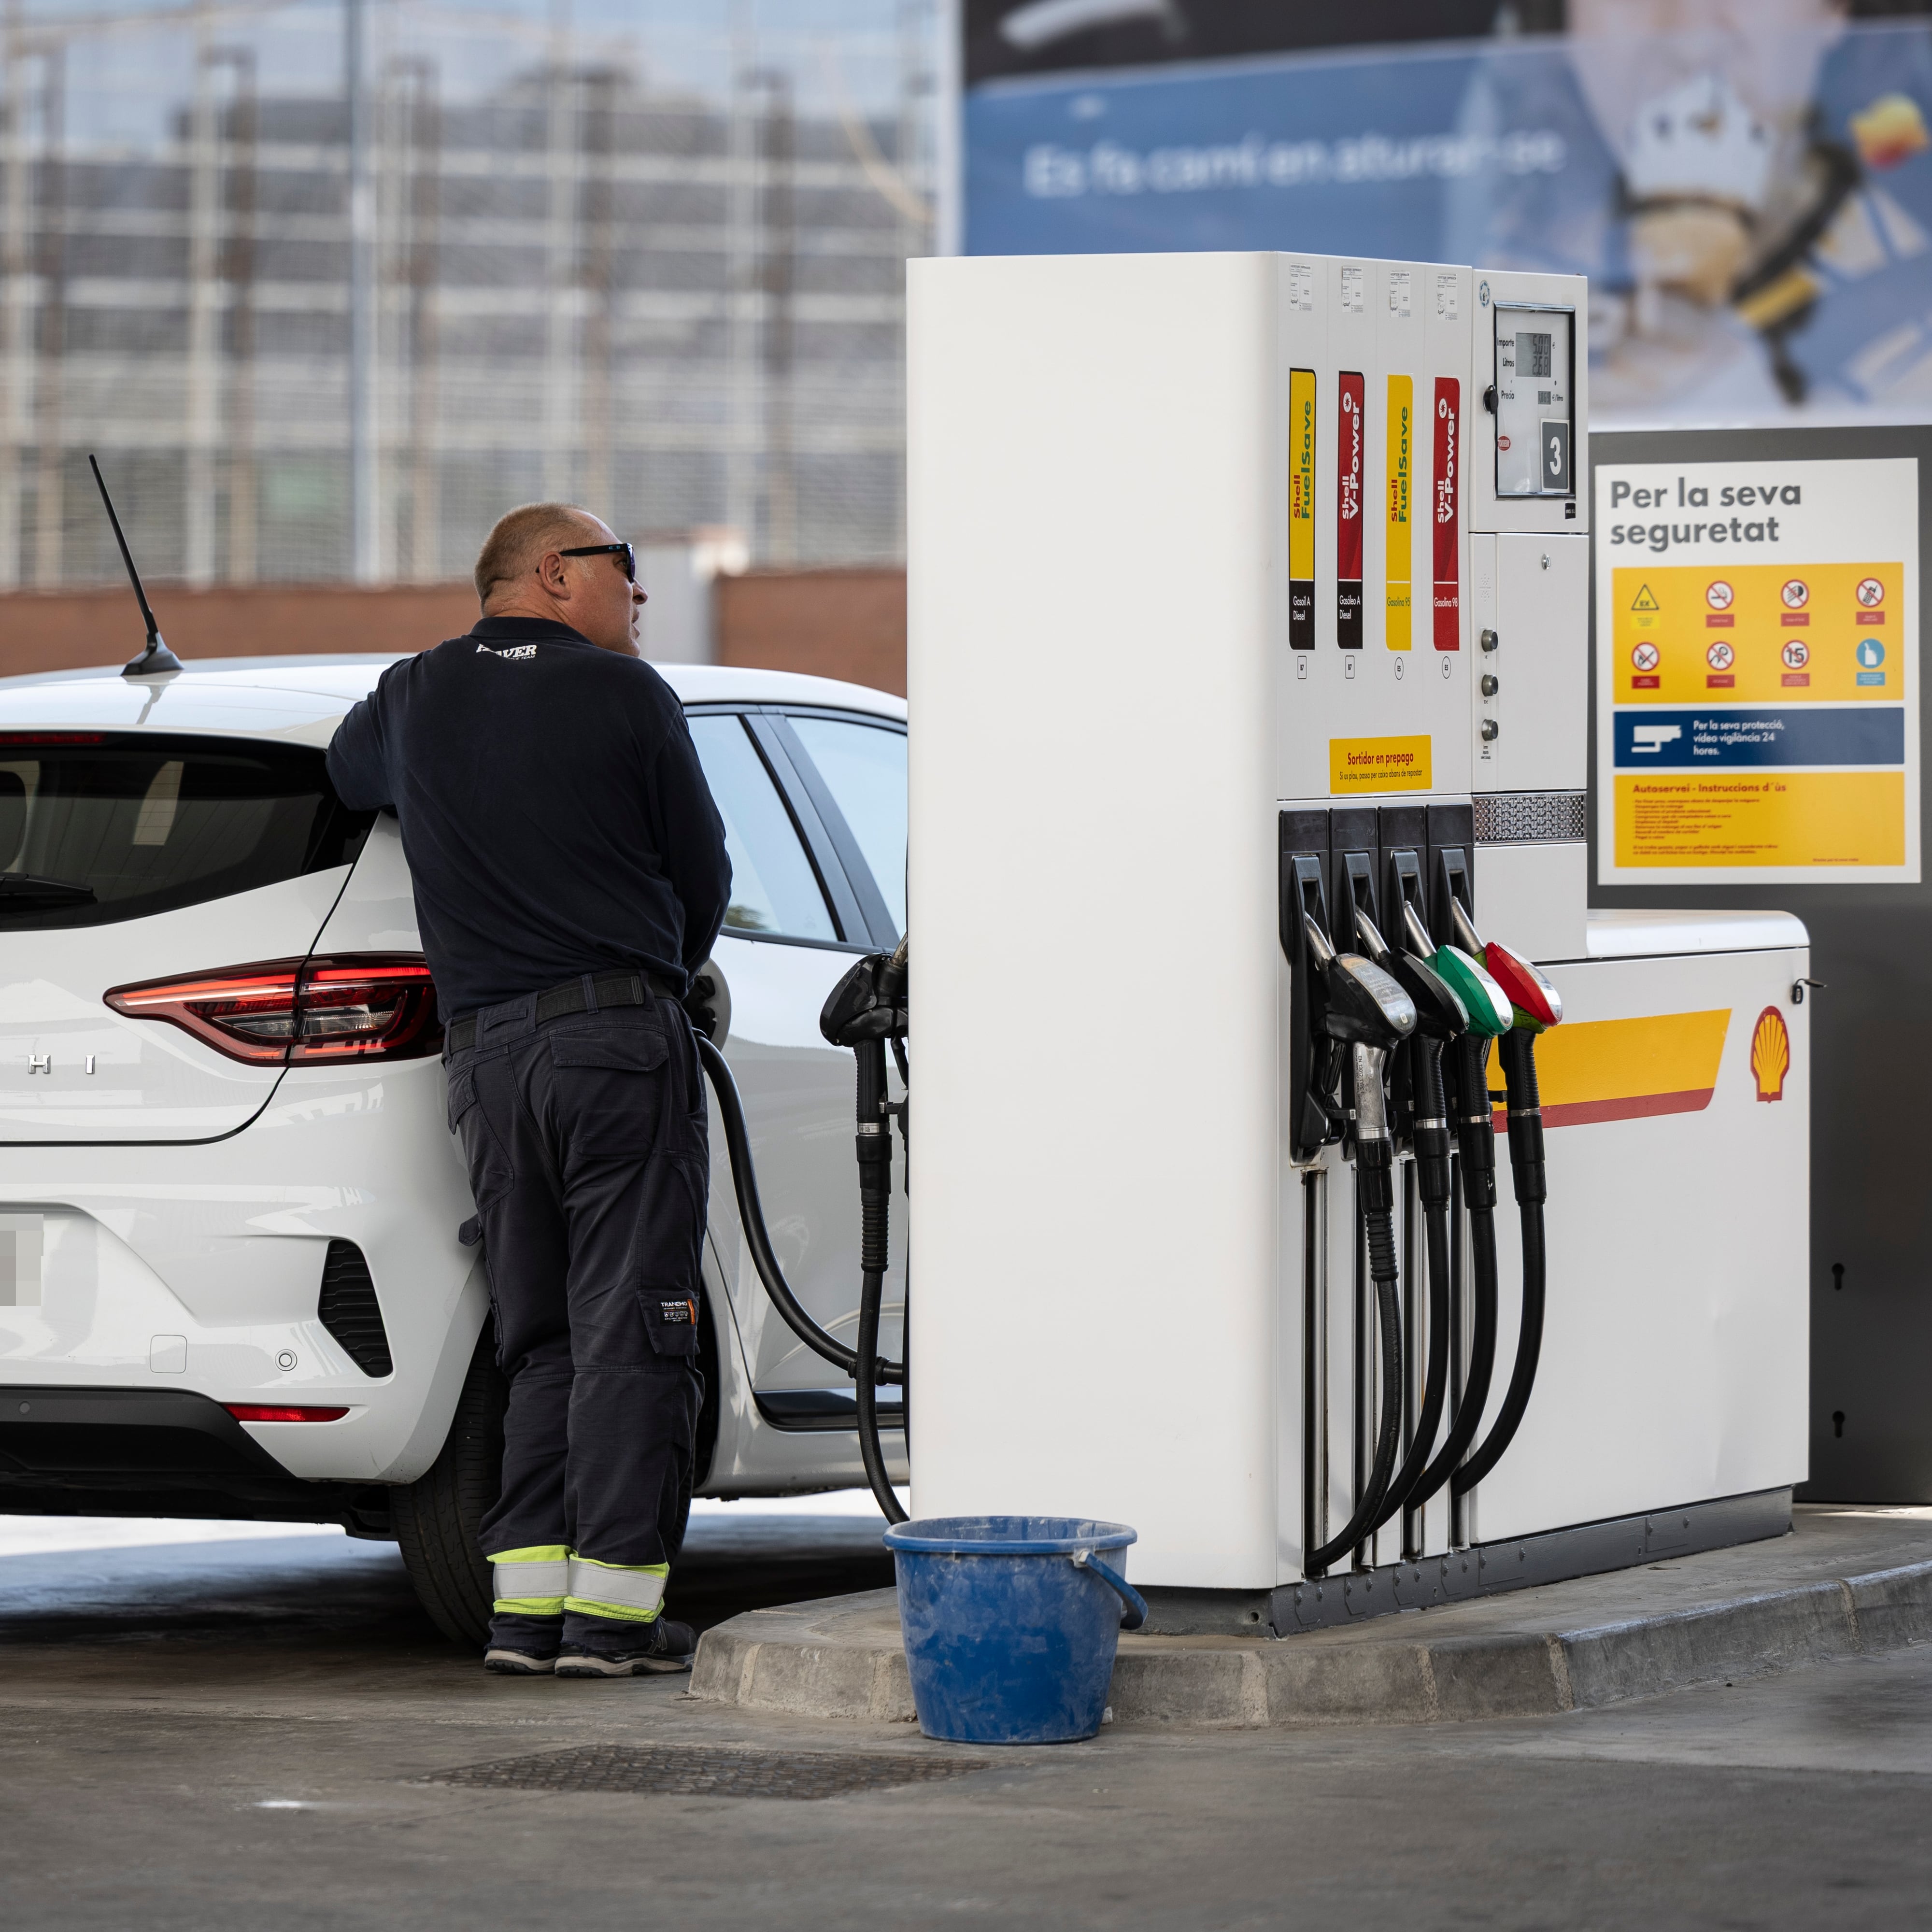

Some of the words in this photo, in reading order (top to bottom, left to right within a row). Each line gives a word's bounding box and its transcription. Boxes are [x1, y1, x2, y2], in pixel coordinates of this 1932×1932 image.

[1497, 338, 1514, 349] Importe
[1503, 357, 1514, 367] Litros
[1501, 390, 1514, 399] Precio
[1301, 400, 1311, 519] FuelSave
[1350, 402, 1360, 519] V-Power
[1549, 437, 1561, 475] 3
[1398, 407, 1407, 523] FuelSave
[1445, 408, 1454, 523] V-Power
[1611, 481, 1667, 508] Per
[1678, 477, 1708, 507] la
[1720, 484, 1801, 507] seva
[1610, 517, 1779, 553] seguretat
[1293, 596, 1306, 606] Gasoil
[1307, 596, 1310, 606] A
[1339, 595, 1356, 605] Gasóleo
[1357, 596, 1361, 605] A
[1387, 597, 1404, 606] Gasolina
[1405, 597, 1410, 606] 95
[1434, 597, 1451, 607] Gasolina
[1452, 597, 1458, 607] 98
[1293, 610, 1305, 620] Diesel
[1339, 609, 1351, 619] Diesel
[1786, 647, 1804, 663] 15
[1693, 720, 1708, 730] Per
[1709, 719, 1718, 730] la
[1742, 719, 1784, 732] protecció,
[1693, 732, 1718, 742] vídeo
[1762, 732, 1775, 742] 24
[1693, 745, 1719, 755] hores.
[1348, 751, 1374, 765] Sortidor
[1376, 755, 1384, 764] en
[1386, 753, 1414, 767] prepago
[1340, 771, 1343, 780] Si
[1349, 770, 1358, 782] plau,
[1359, 773, 1370, 781] passa
[1378, 770, 1388, 778] caixa
[1389, 768, 1400, 778] abans
[1401, 768, 1406, 777] de
[1407, 769, 1422, 780] repostar
[1633, 783, 1690, 792] Autoservei
[1699, 782, 1760, 792] Instruccions
